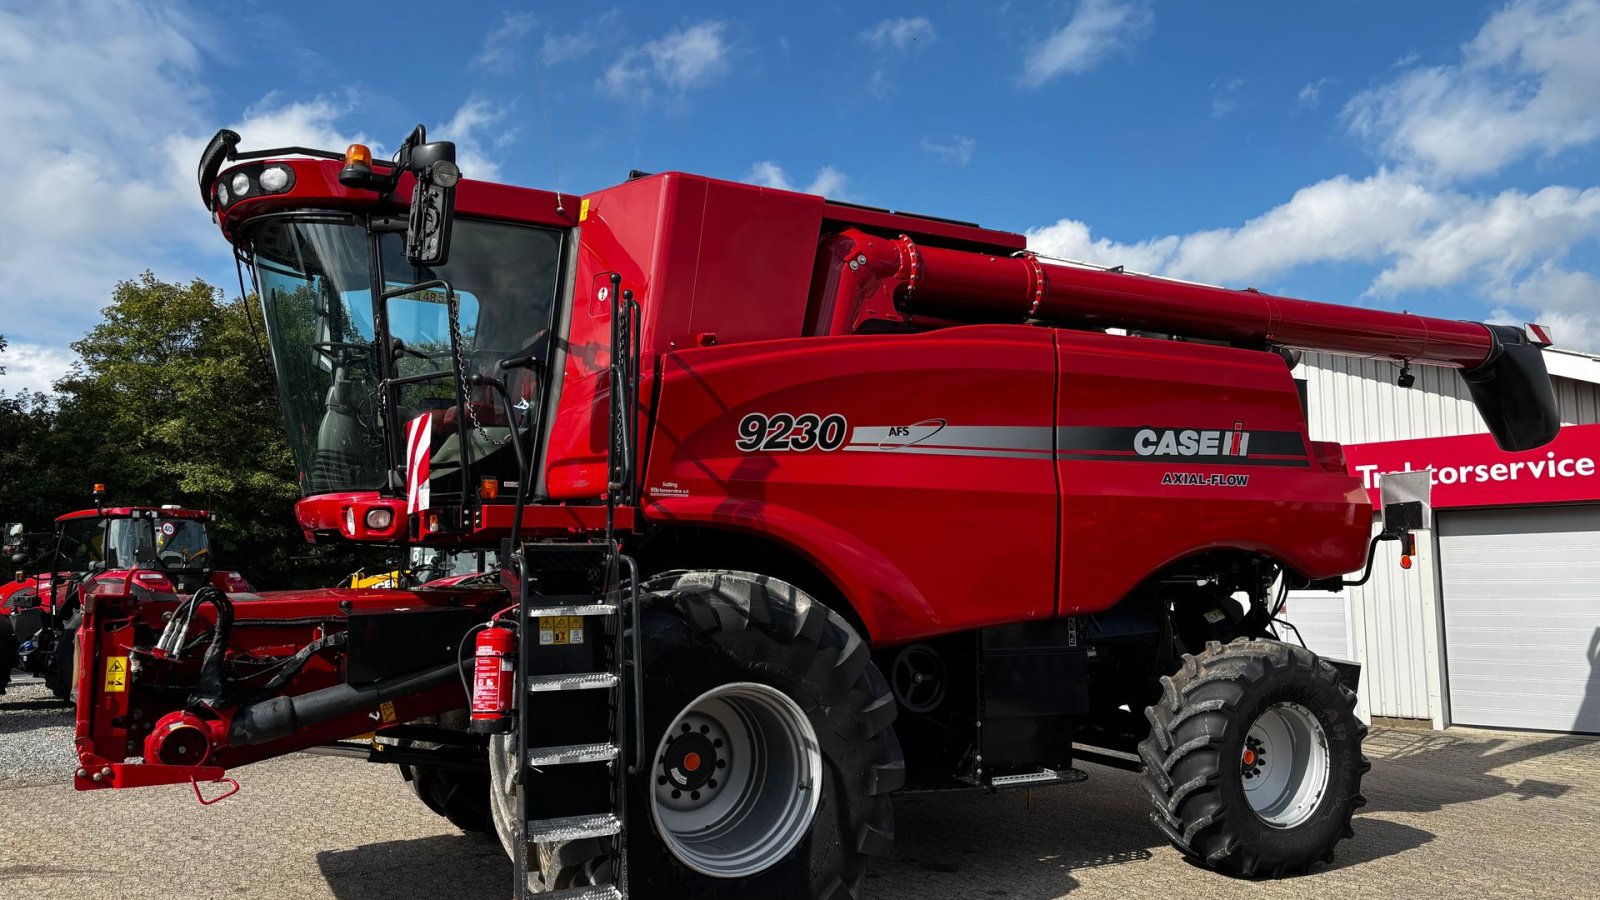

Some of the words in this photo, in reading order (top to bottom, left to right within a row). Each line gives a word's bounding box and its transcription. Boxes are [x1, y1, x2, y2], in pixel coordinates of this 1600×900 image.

[736, 412, 848, 451] 9230
[888, 426, 910, 437] AFS
[1133, 428, 1220, 456] CASE
[1161, 471, 1250, 487] AXIAL-FLOW
[1355, 451, 1595, 489] Trtorservice
